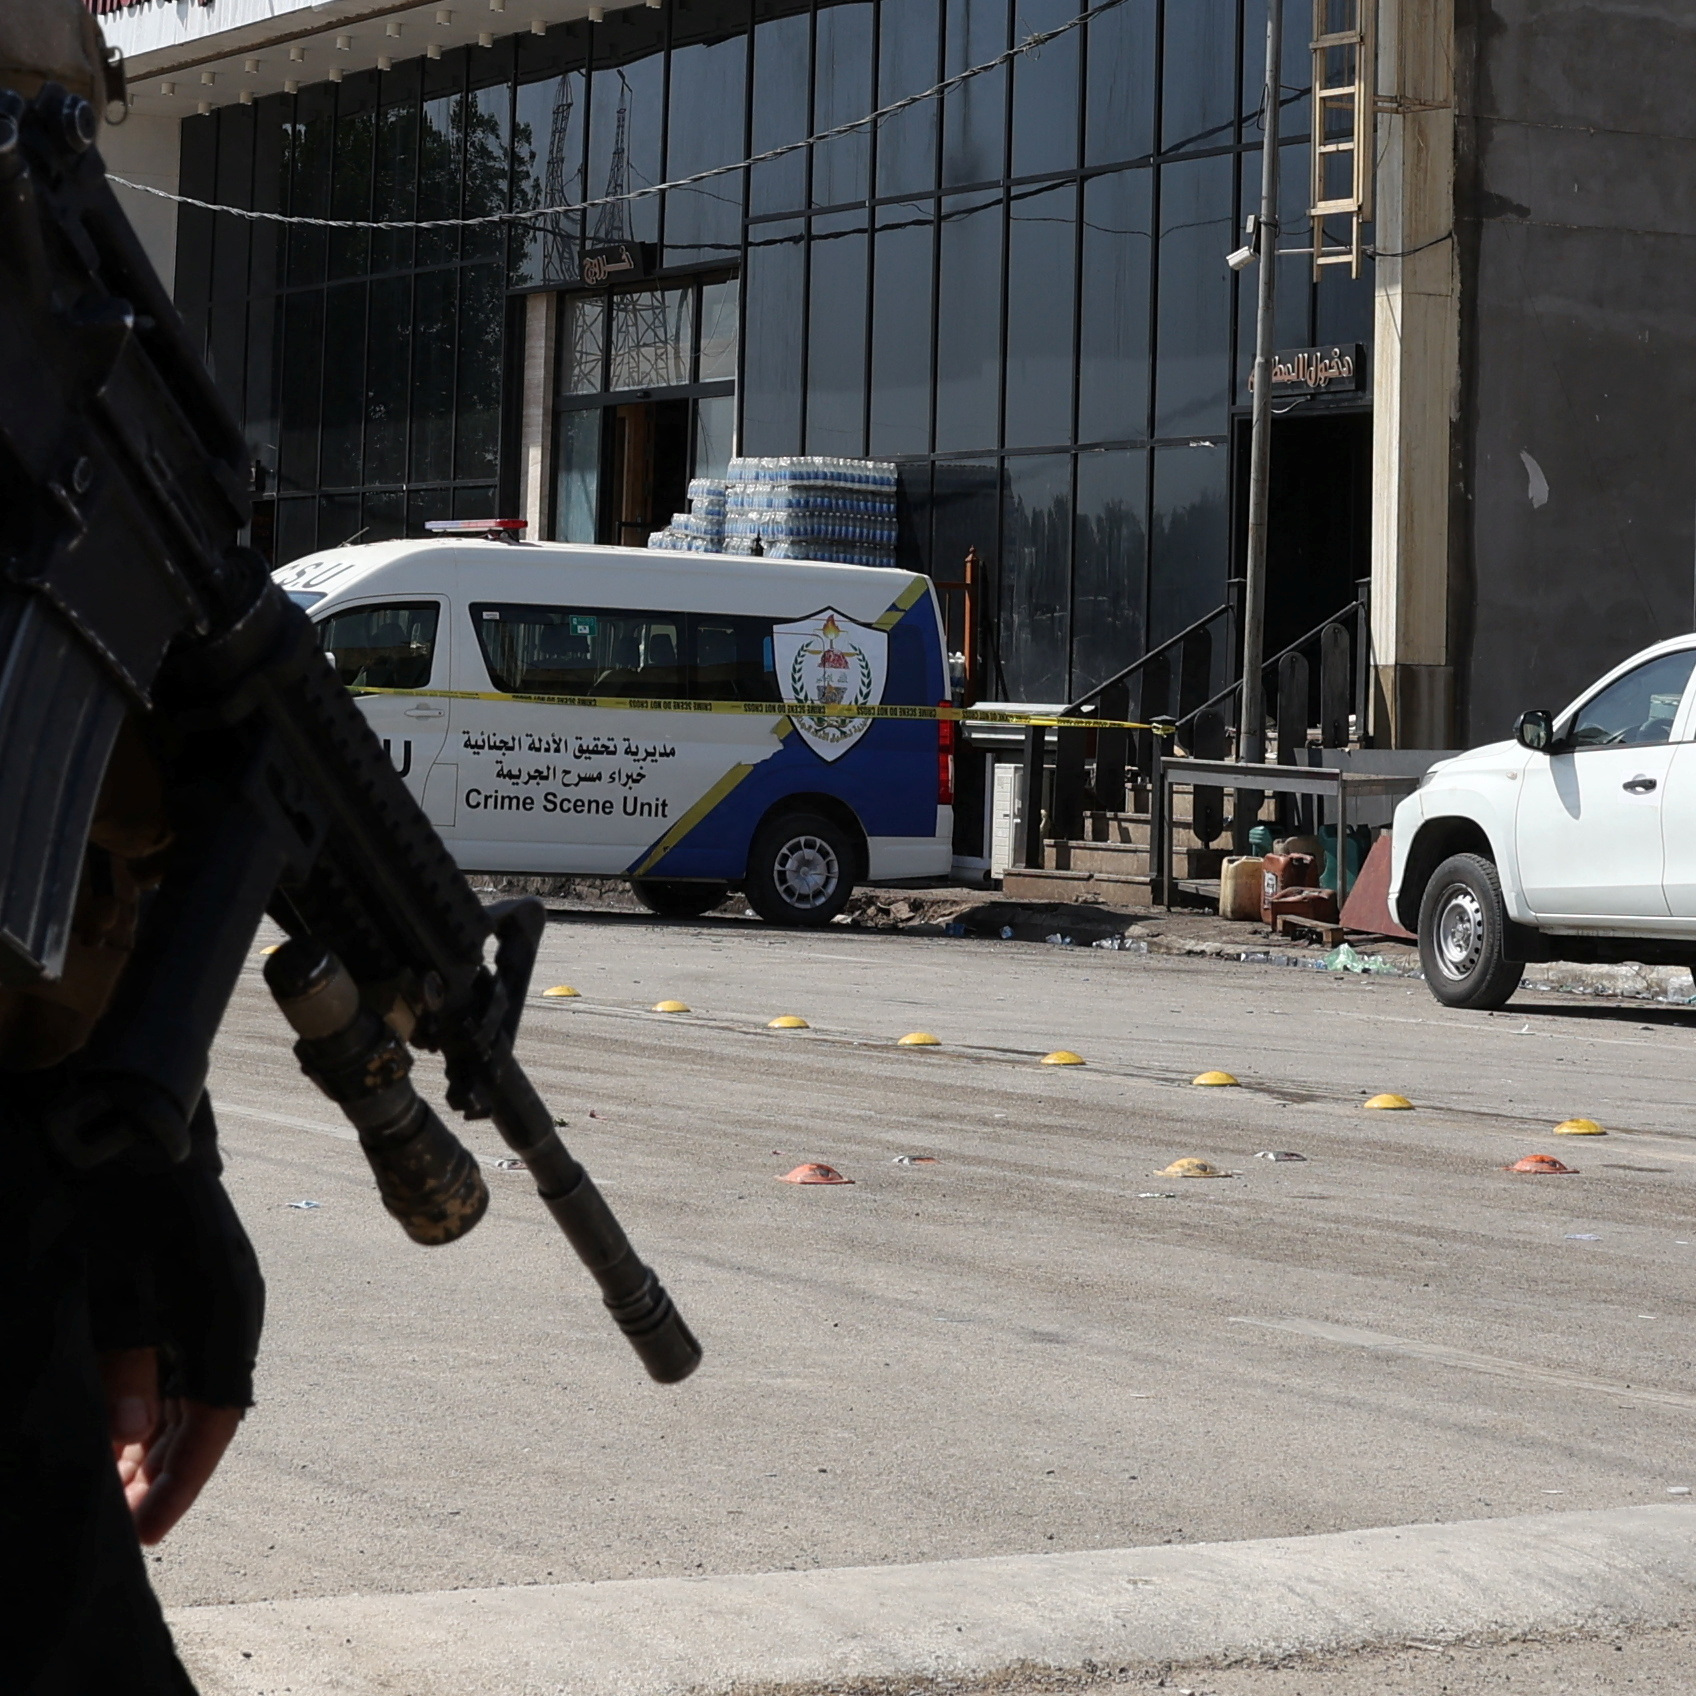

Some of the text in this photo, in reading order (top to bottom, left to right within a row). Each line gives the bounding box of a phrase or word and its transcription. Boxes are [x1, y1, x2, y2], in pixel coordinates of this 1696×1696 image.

[583, 246, 634, 284] خروج
[1306, 348, 1353, 387] دخول
[856, 706, 875, 716] CROSS
[877, 706, 888, 717] NOT
[898, 707, 917, 718] SCENE
[918, 708, 937, 719] CRIME
[462, 730, 677, 763] مديرية تحقيق الأدلة الجنائية
[495, 760, 647, 791] خبراء مسرح الجريمة
[465, 788, 669, 818] Crime Scene Unit
